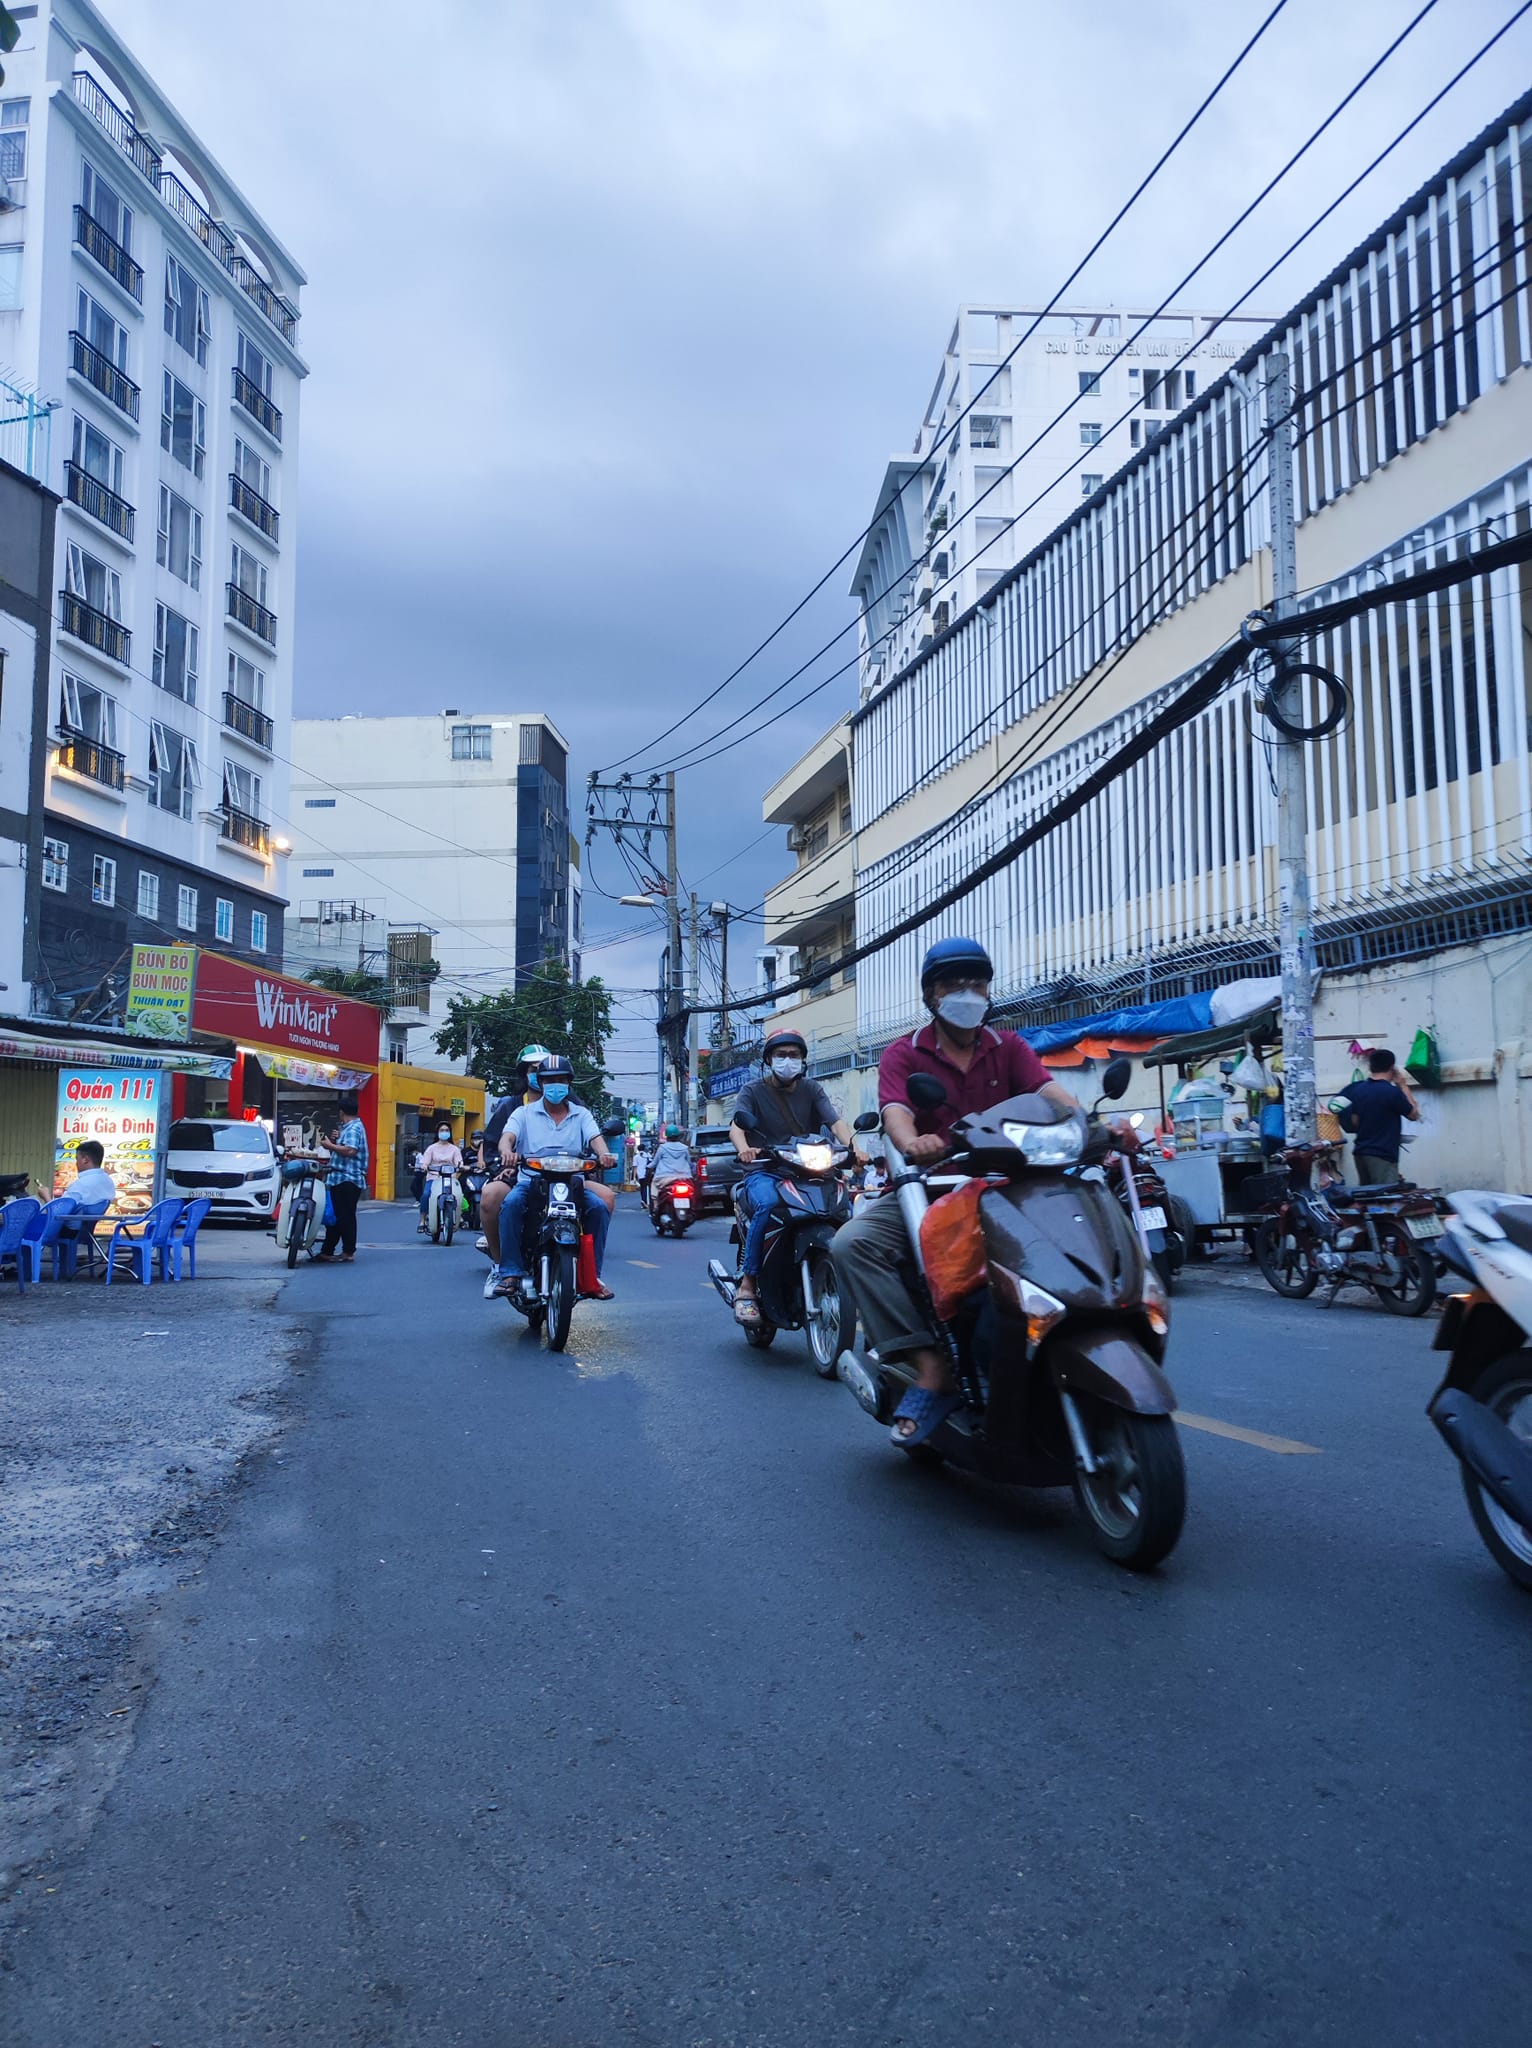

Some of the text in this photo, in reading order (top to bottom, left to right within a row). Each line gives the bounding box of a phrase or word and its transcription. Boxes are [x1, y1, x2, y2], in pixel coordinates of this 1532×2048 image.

[161, 975, 189, 994] MỌC
[176, 1056, 199, 1067] 336
[67, 1077, 113, 1101] Quán
[63, 1114, 155, 1134] Lẩu Gia Đình
